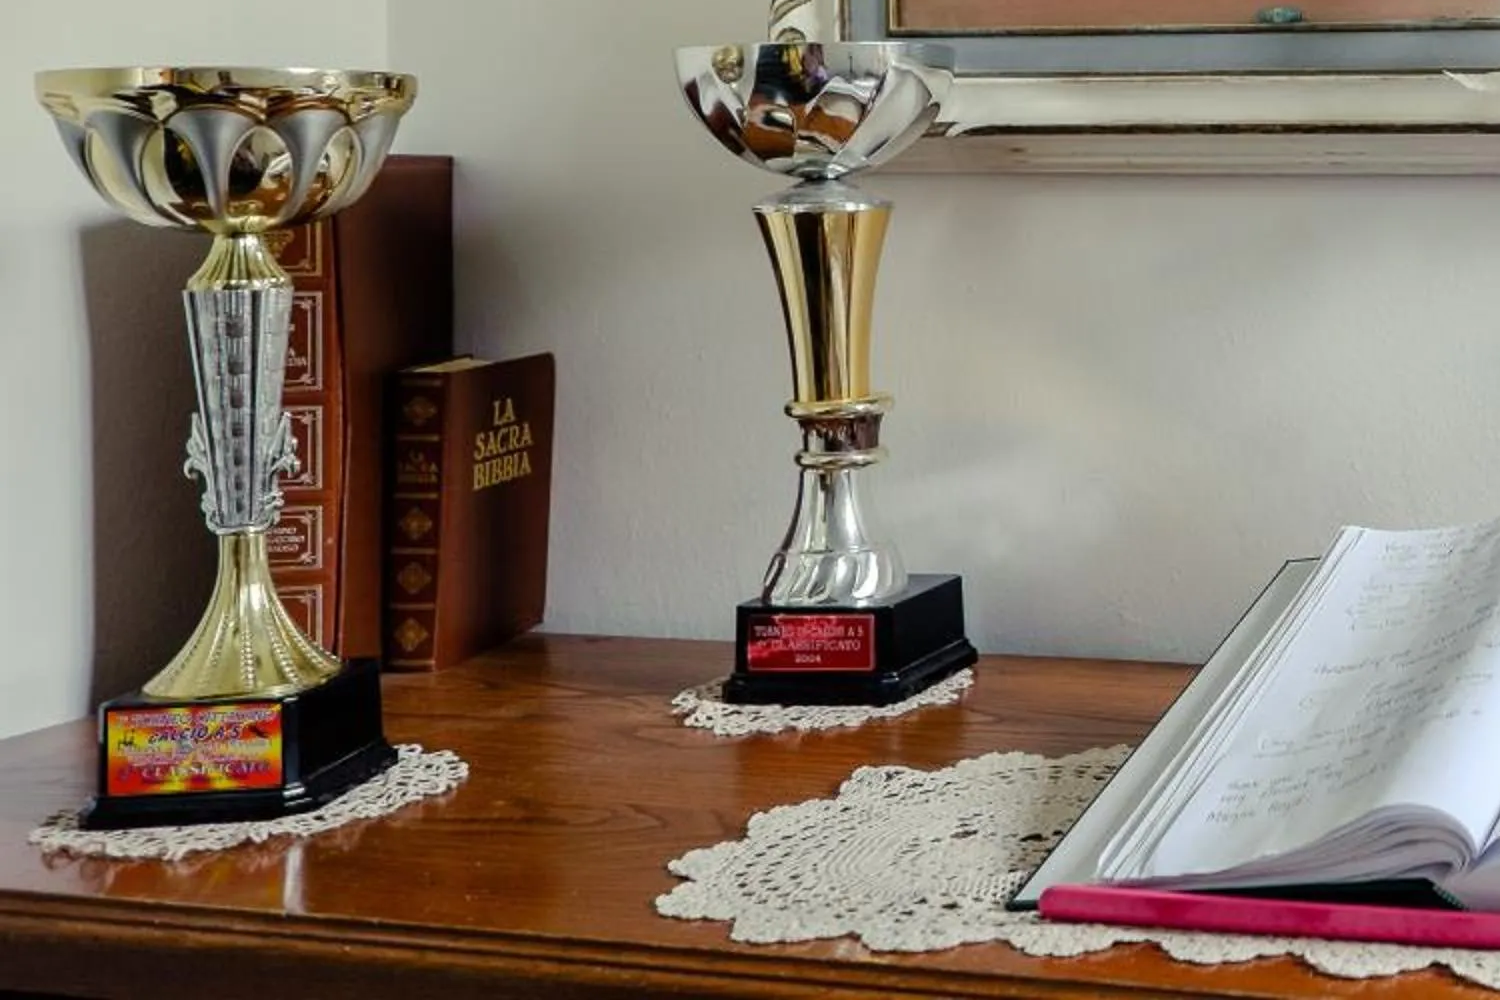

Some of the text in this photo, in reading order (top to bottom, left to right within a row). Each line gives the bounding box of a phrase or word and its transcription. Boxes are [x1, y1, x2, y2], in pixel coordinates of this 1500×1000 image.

[494, 398, 515, 425] LA
[473, 421, 534, 461] SACRA
[473, 450, 532, 492] BIBBIA
[771, 639, 861, 651] CLASSIFICATO
[148, 726, 208, 745] CALCIO
